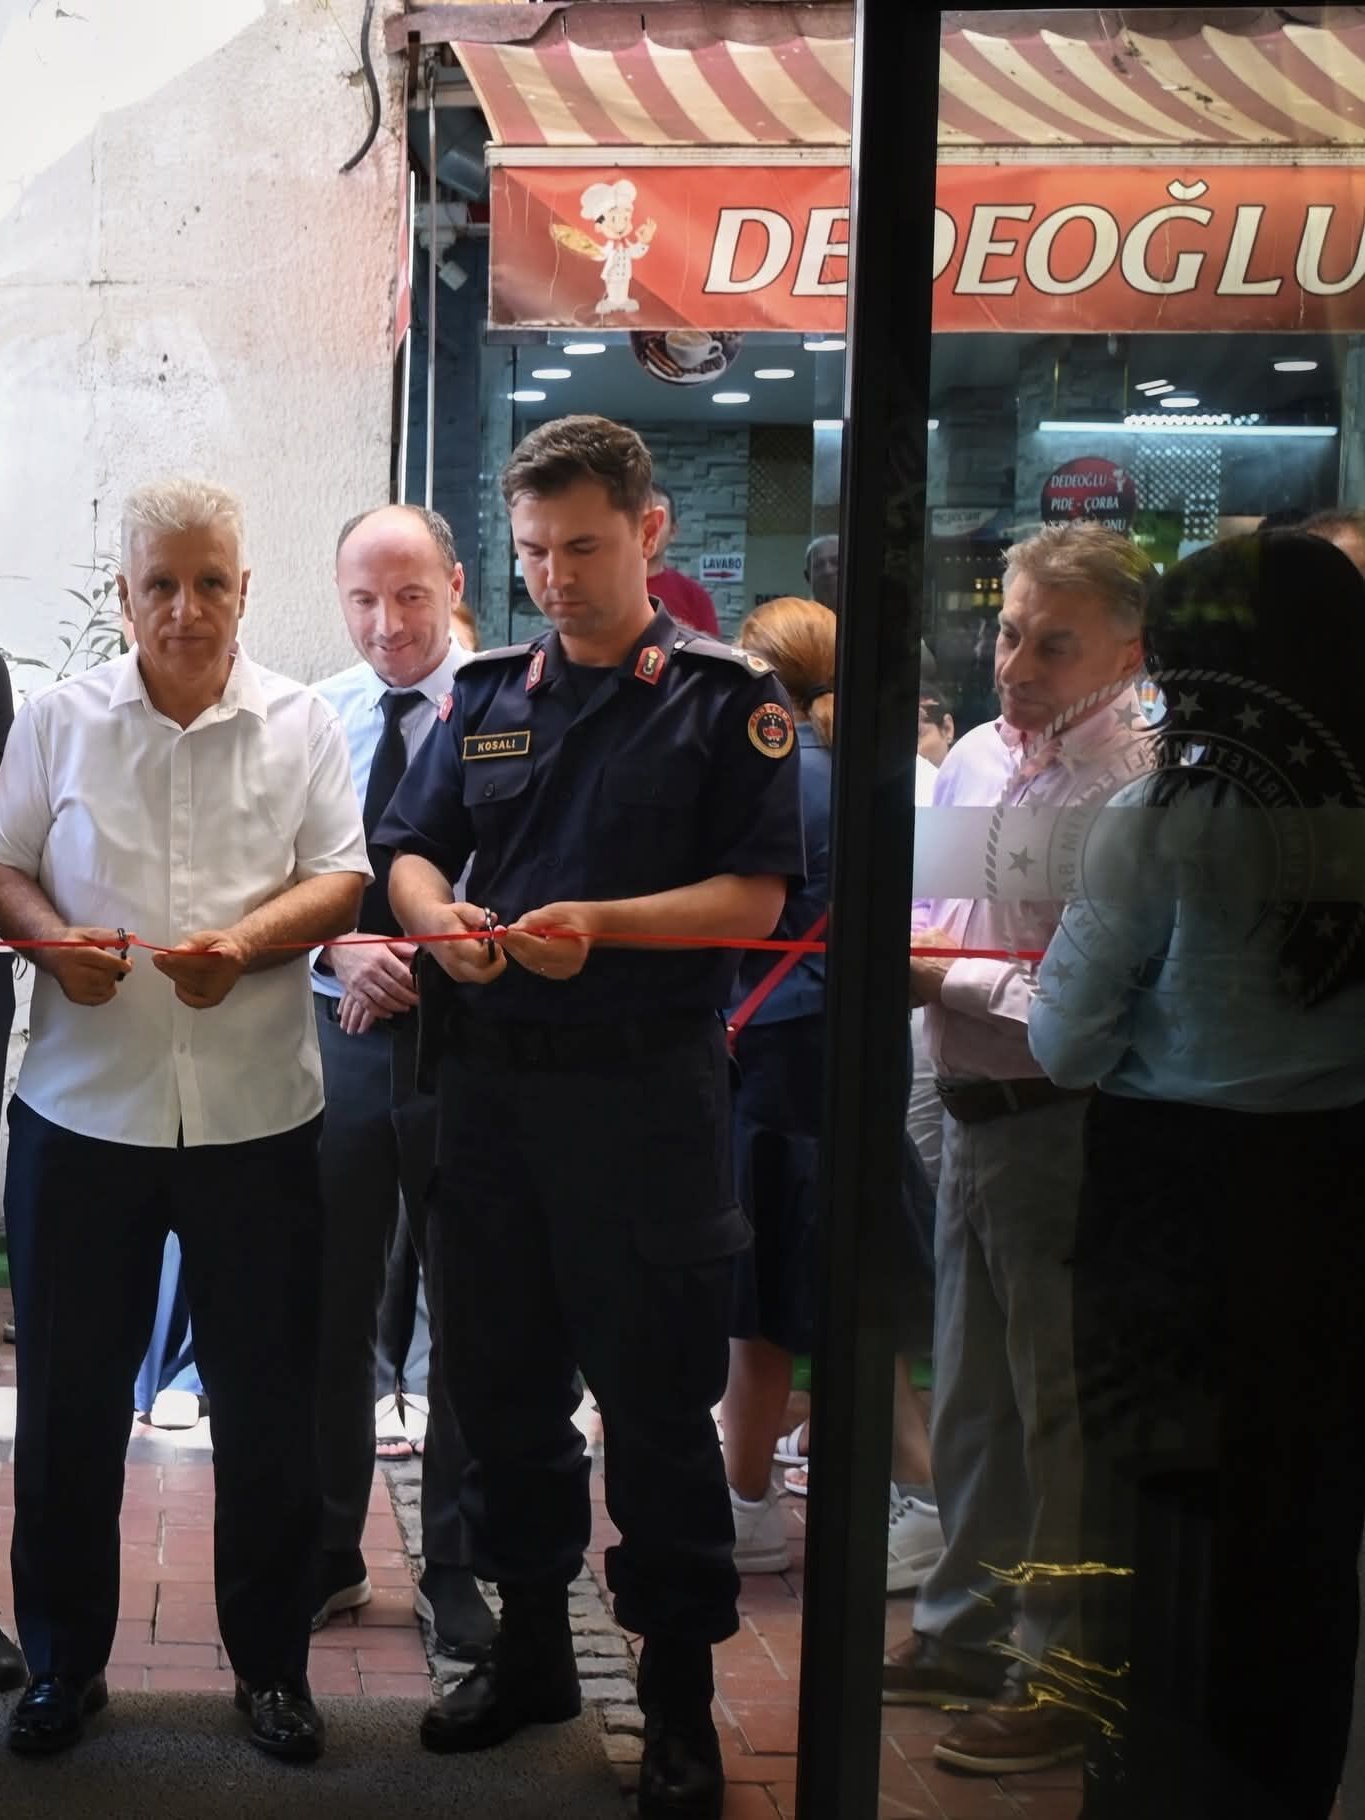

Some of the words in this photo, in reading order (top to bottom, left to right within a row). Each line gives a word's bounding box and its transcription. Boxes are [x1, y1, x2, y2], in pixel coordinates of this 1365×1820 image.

[702, 178, 1365, 297] DEEOĞLU
[1050, 472, 1107, 488] DEDEOĞLU
[1050, 496, 1075, 512] PİDE
[1084, 496, 1119, 512] ÇORBA
[703, 557, 742, 570] LAVABO
